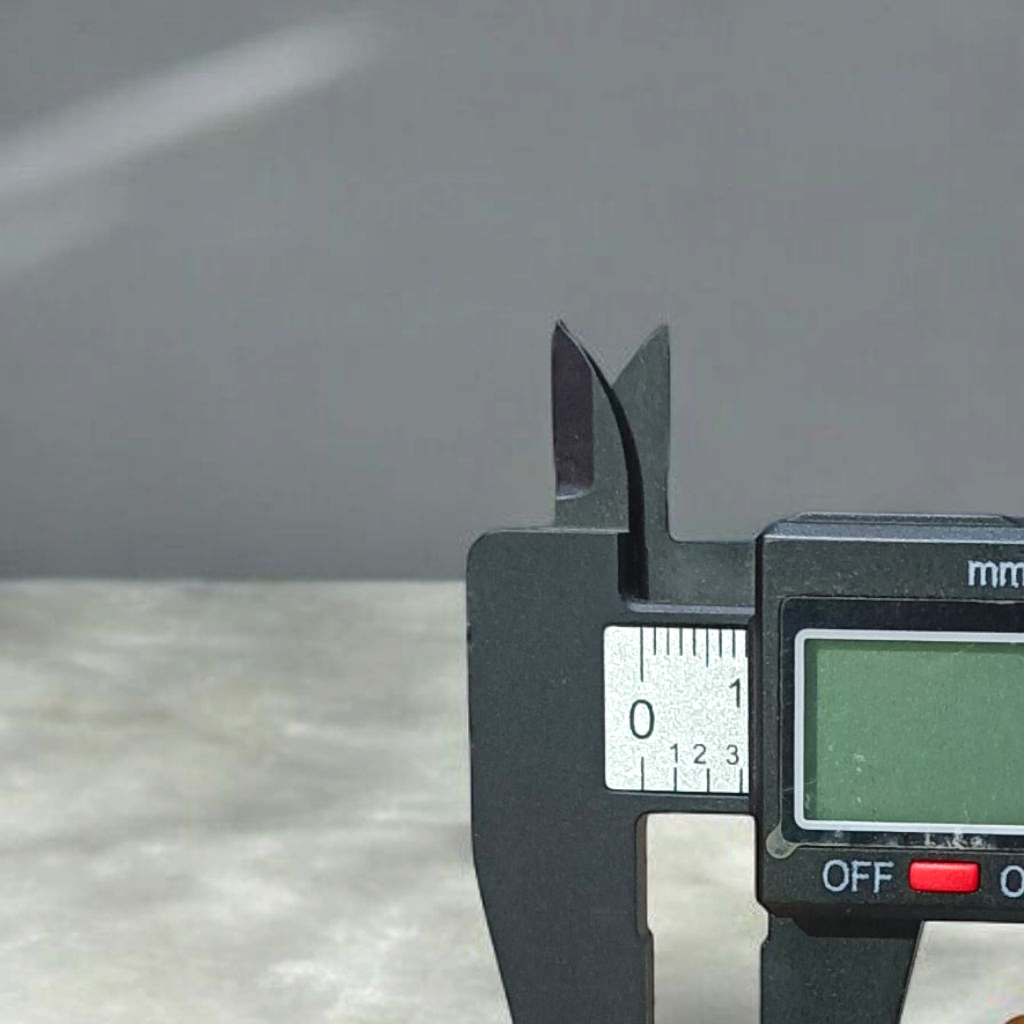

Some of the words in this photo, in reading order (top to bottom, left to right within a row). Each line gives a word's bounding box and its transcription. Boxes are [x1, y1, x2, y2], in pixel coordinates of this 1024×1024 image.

[629, 699, 655, 739] 0
[693, 743, 707, 764] 2
[726, 744, 740, 765] 3
[822, 858, 894, 894] OFF
